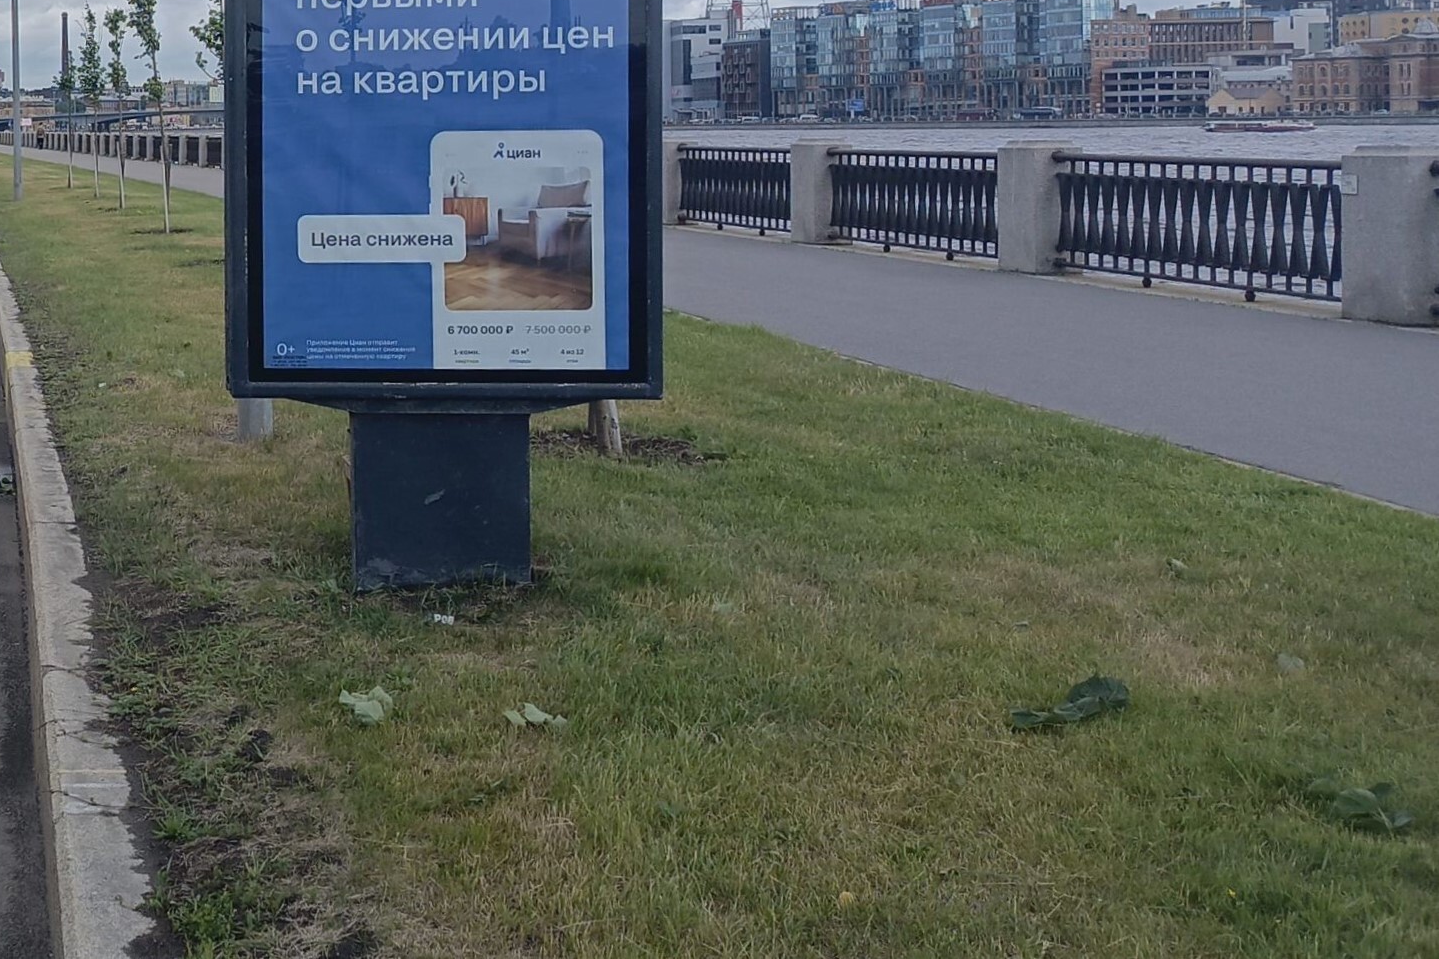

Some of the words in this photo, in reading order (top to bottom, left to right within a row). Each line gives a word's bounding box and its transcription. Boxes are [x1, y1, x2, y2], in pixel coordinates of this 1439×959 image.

[295, 28, 319, 53] о
[328, 26, 530, 53] снижении
[542, 25, 615, 55] цен
[296, 70, 343, 95] на
[353, 68, 546, 102] квартиры
[506, 148, 541, 161] циан
[311, 232, 362, 249] Цена
[366, 233, 454, 248] снижена
[447, 325, 455, 335] 6
[457, 325, 479, 335] 700
[480, 325, 504, 335] 000
[533, 325, 556, 335] 500
[557, 325, 582, 335] 000
[276, 343, 295, 356] 0+
